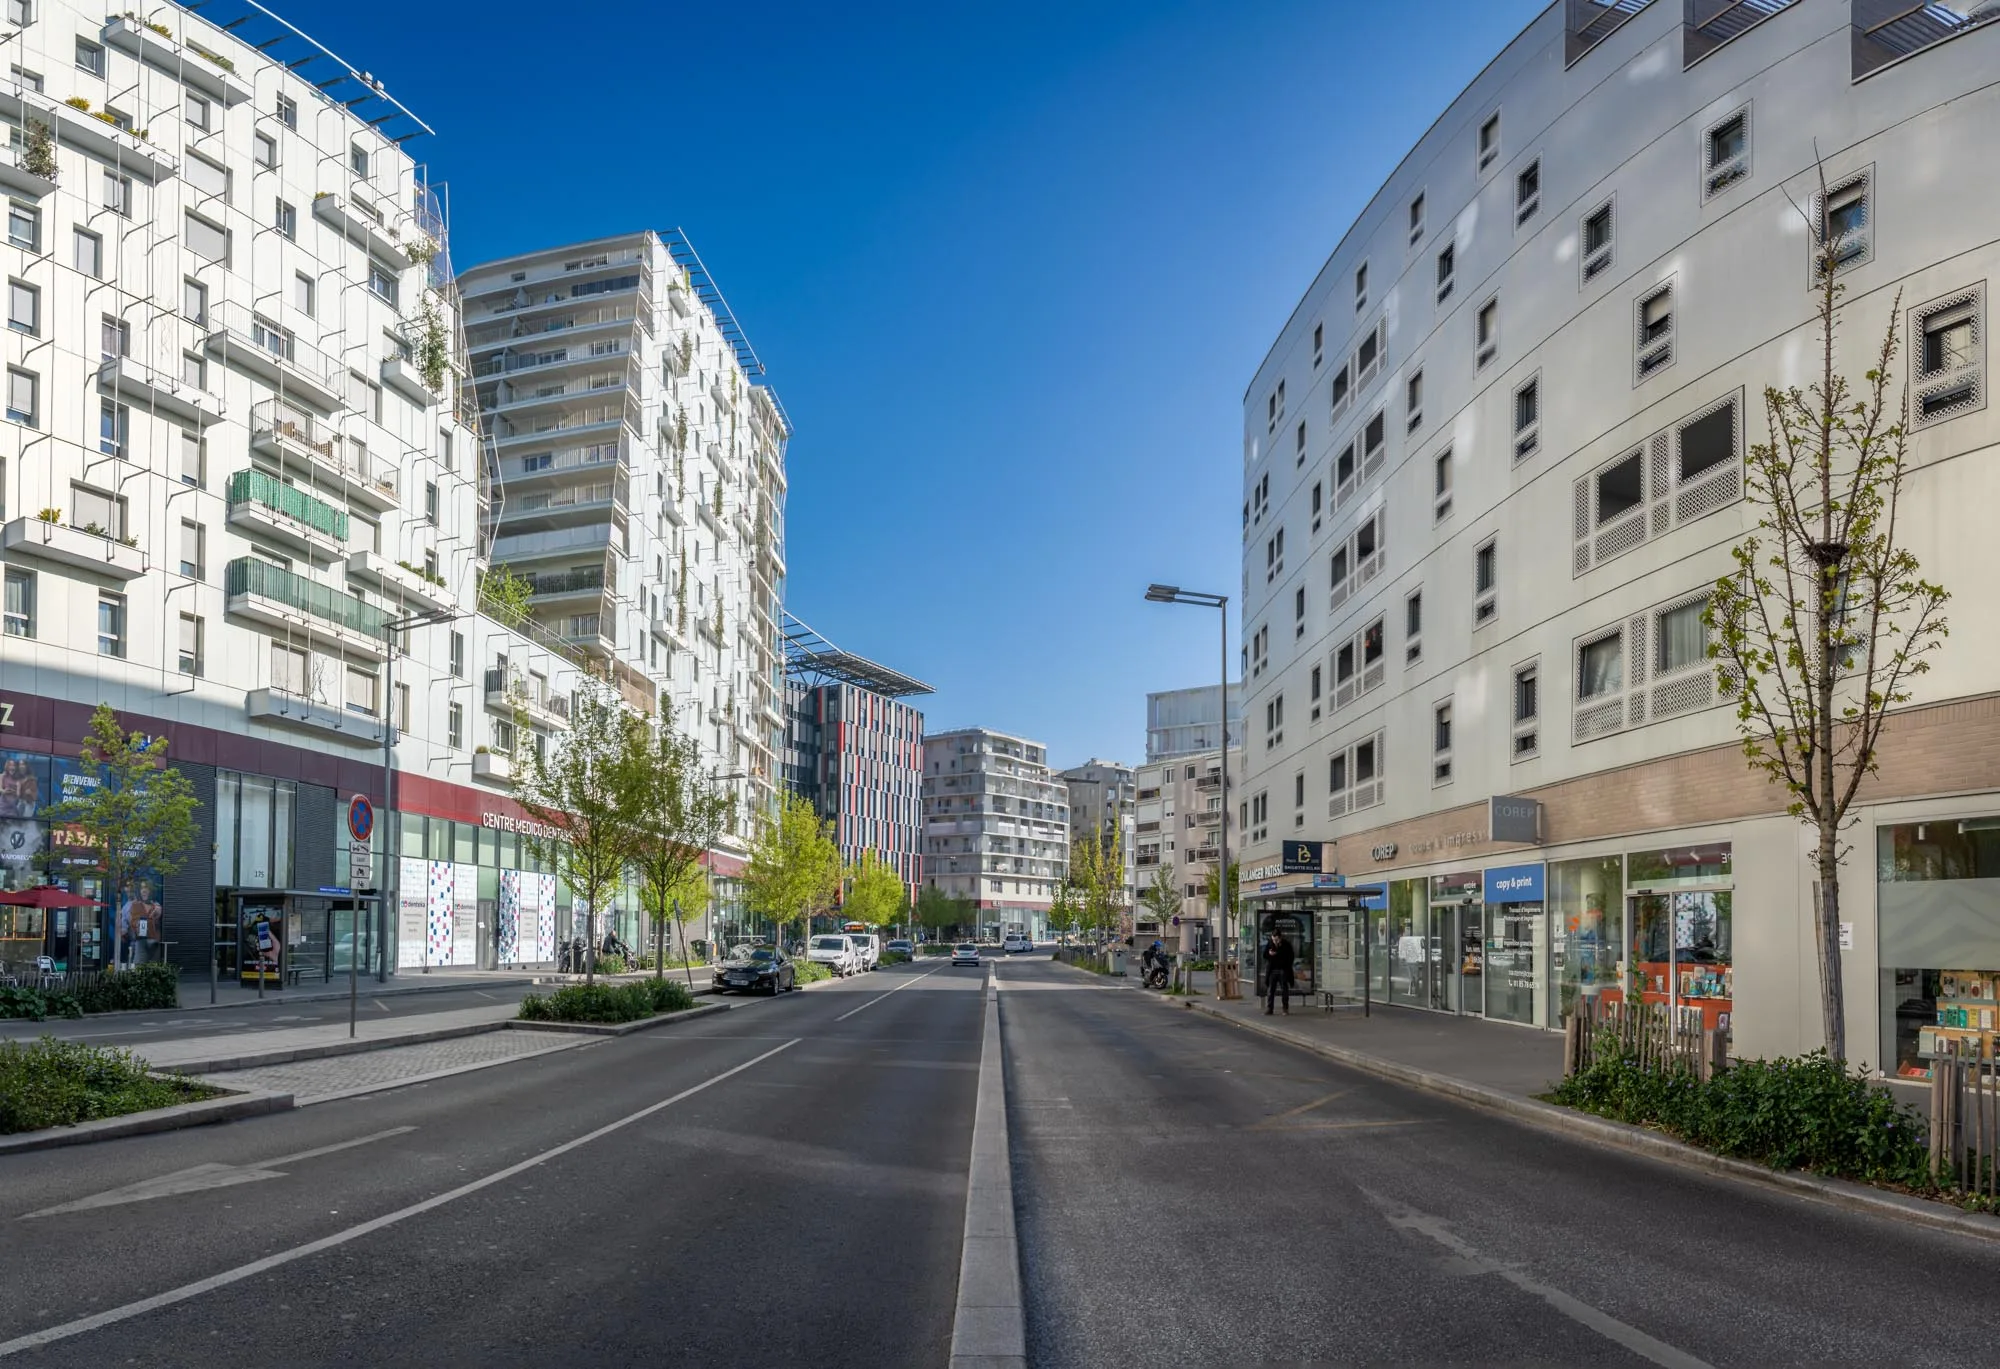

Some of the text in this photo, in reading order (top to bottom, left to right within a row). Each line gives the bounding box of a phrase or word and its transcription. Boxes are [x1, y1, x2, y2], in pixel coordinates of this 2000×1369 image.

[63, 774, 101, 787] BENVENUE
[1495, 805, 1534, 818] COREP
[483, 812, 514, 832] CENTRE
[515, 819, 542, 837] MEDICO
[1496, 876, 1532, 891] copy & print
